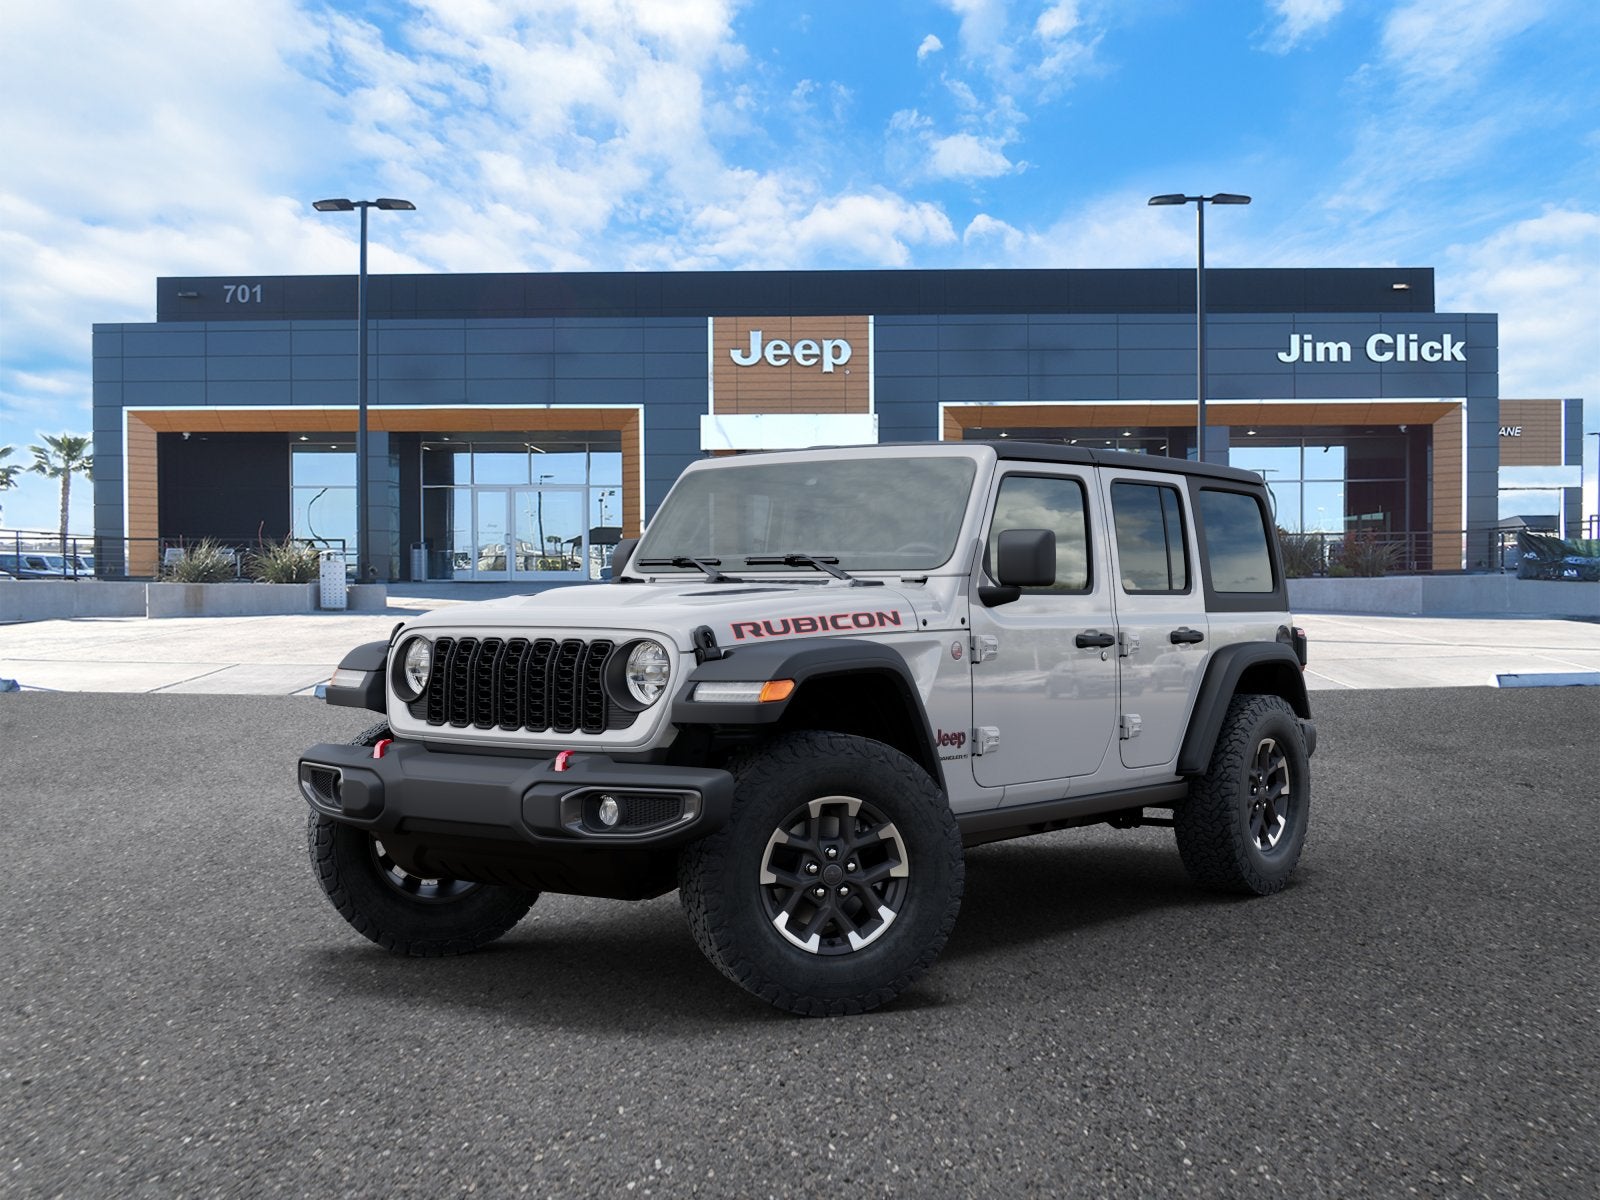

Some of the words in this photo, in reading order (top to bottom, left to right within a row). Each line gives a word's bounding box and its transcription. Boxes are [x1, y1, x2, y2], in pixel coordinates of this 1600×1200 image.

[223, 284, 262, 303] 701
[729, 330, 853, 374] Jeep
[1277, 333, 1352, 363] Jim
[1366, 333, 1467, 363] Click
[1498, 426, 1522, 437] ANE
[730, 610, 902, 640] RUBICON
[935, 728, 966, 749] Jeep
